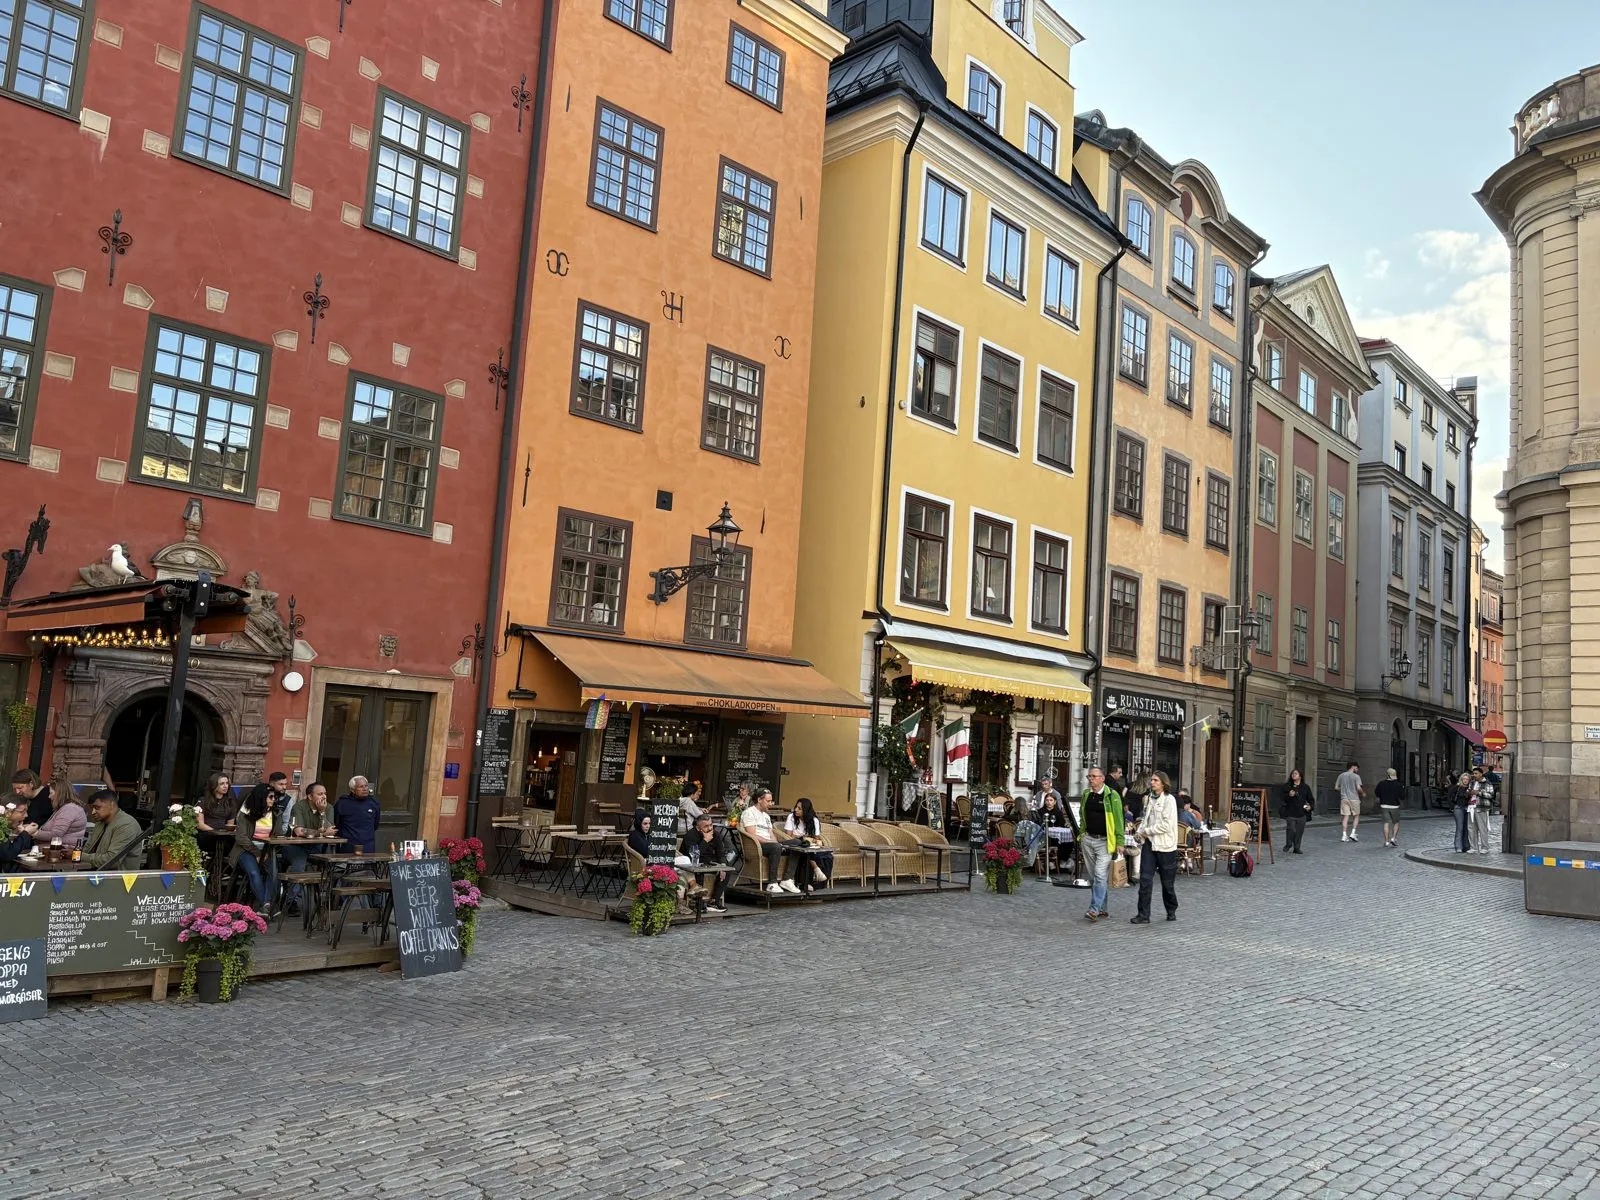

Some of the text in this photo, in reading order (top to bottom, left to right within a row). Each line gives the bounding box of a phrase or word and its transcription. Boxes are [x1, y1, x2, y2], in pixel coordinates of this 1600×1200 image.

[1120, 694, 1174, 713] RUNSTENEN
[1140, 710, 1155, 719] HORSE
[1156, 713, 1175, 721] MUSEUM
[398, 862, 441, 880] WE SERVE
[136, 894, 185, 905] WELCOME
[407, 885, 439, 907] BEER
[409, 904, 442, 928] WINE
[400, 926, 460, 955] COFFEE DRINKS
